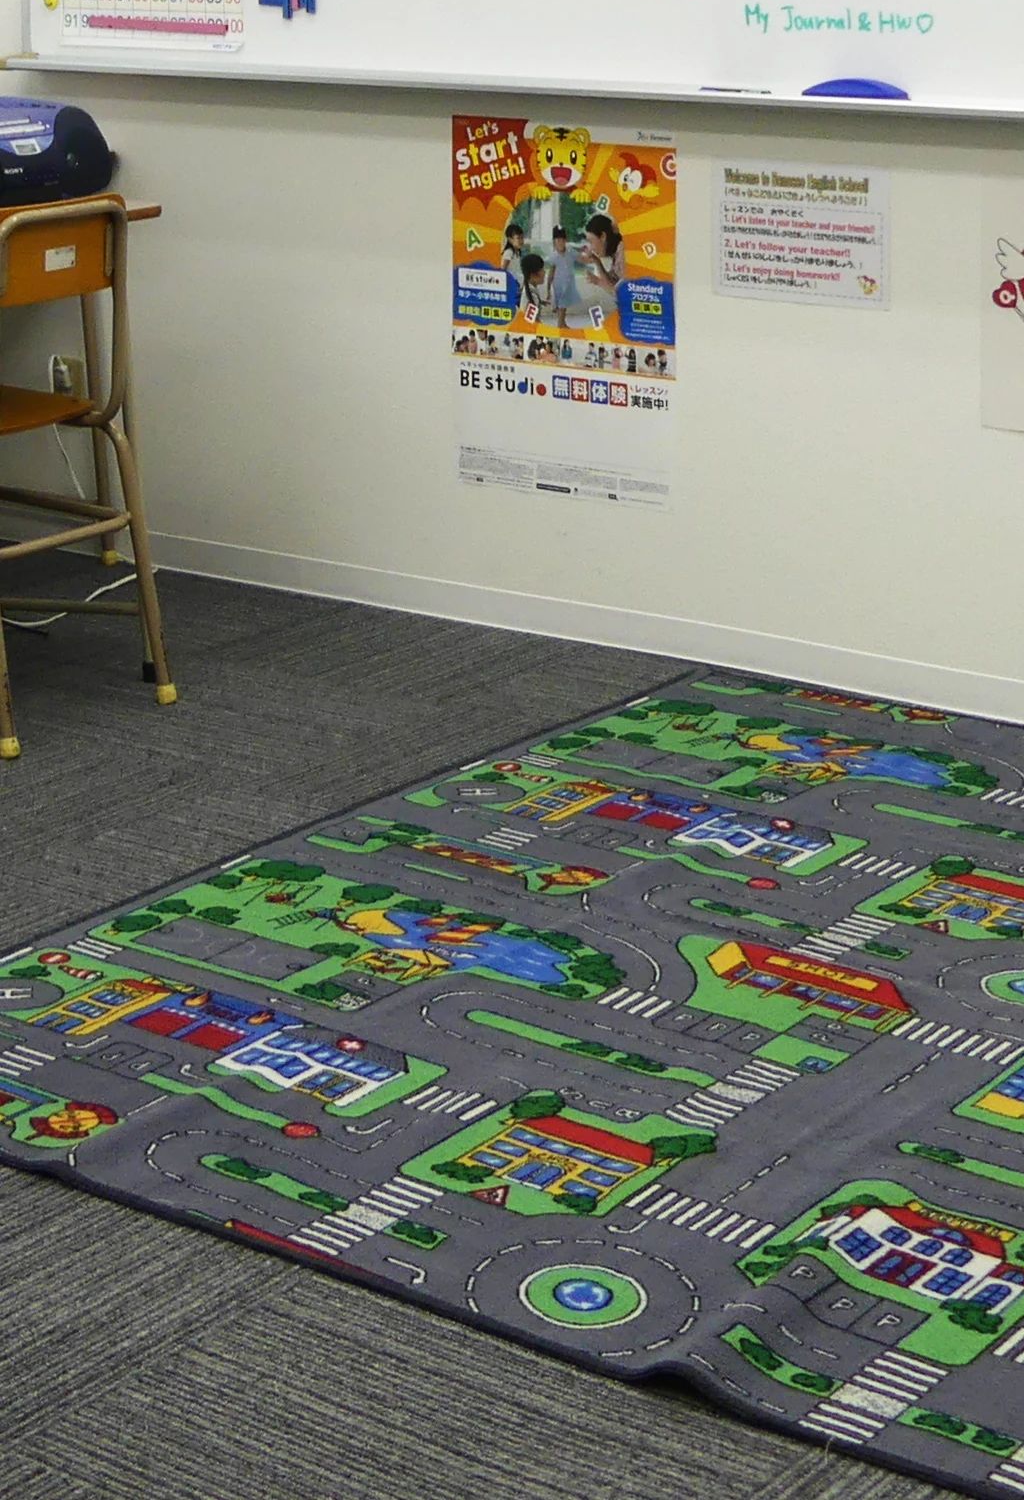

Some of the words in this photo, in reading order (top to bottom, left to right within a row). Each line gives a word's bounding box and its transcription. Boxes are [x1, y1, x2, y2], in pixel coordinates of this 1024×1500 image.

[744, 3, 769, 33] My
[781, 6, 851, 32] Journal
[857, 11, 872, 31] &
[466, 120, 499, 141] Let's
[455, 131, 518, 170] start
[459, 156, 526, 191] English!
[596, 195, 609, 211] B
[467, 228, 482, 249] A
[735, 240, 756, 250] Let's
[759, 242, 785, 252] follow
[788, 245, 808, 256] your
[644, 243, 656, 256] D
[733, 264, 751, 274] Let's
[627, 282, 664, 296] Standard
[526, 305, 537, 322] E
[590, 307, 604, 328] F
[460, 369, 480, 389] BE
[485, 373, 547, 397] studio
[552, 375, 629, 408] 無料体験
